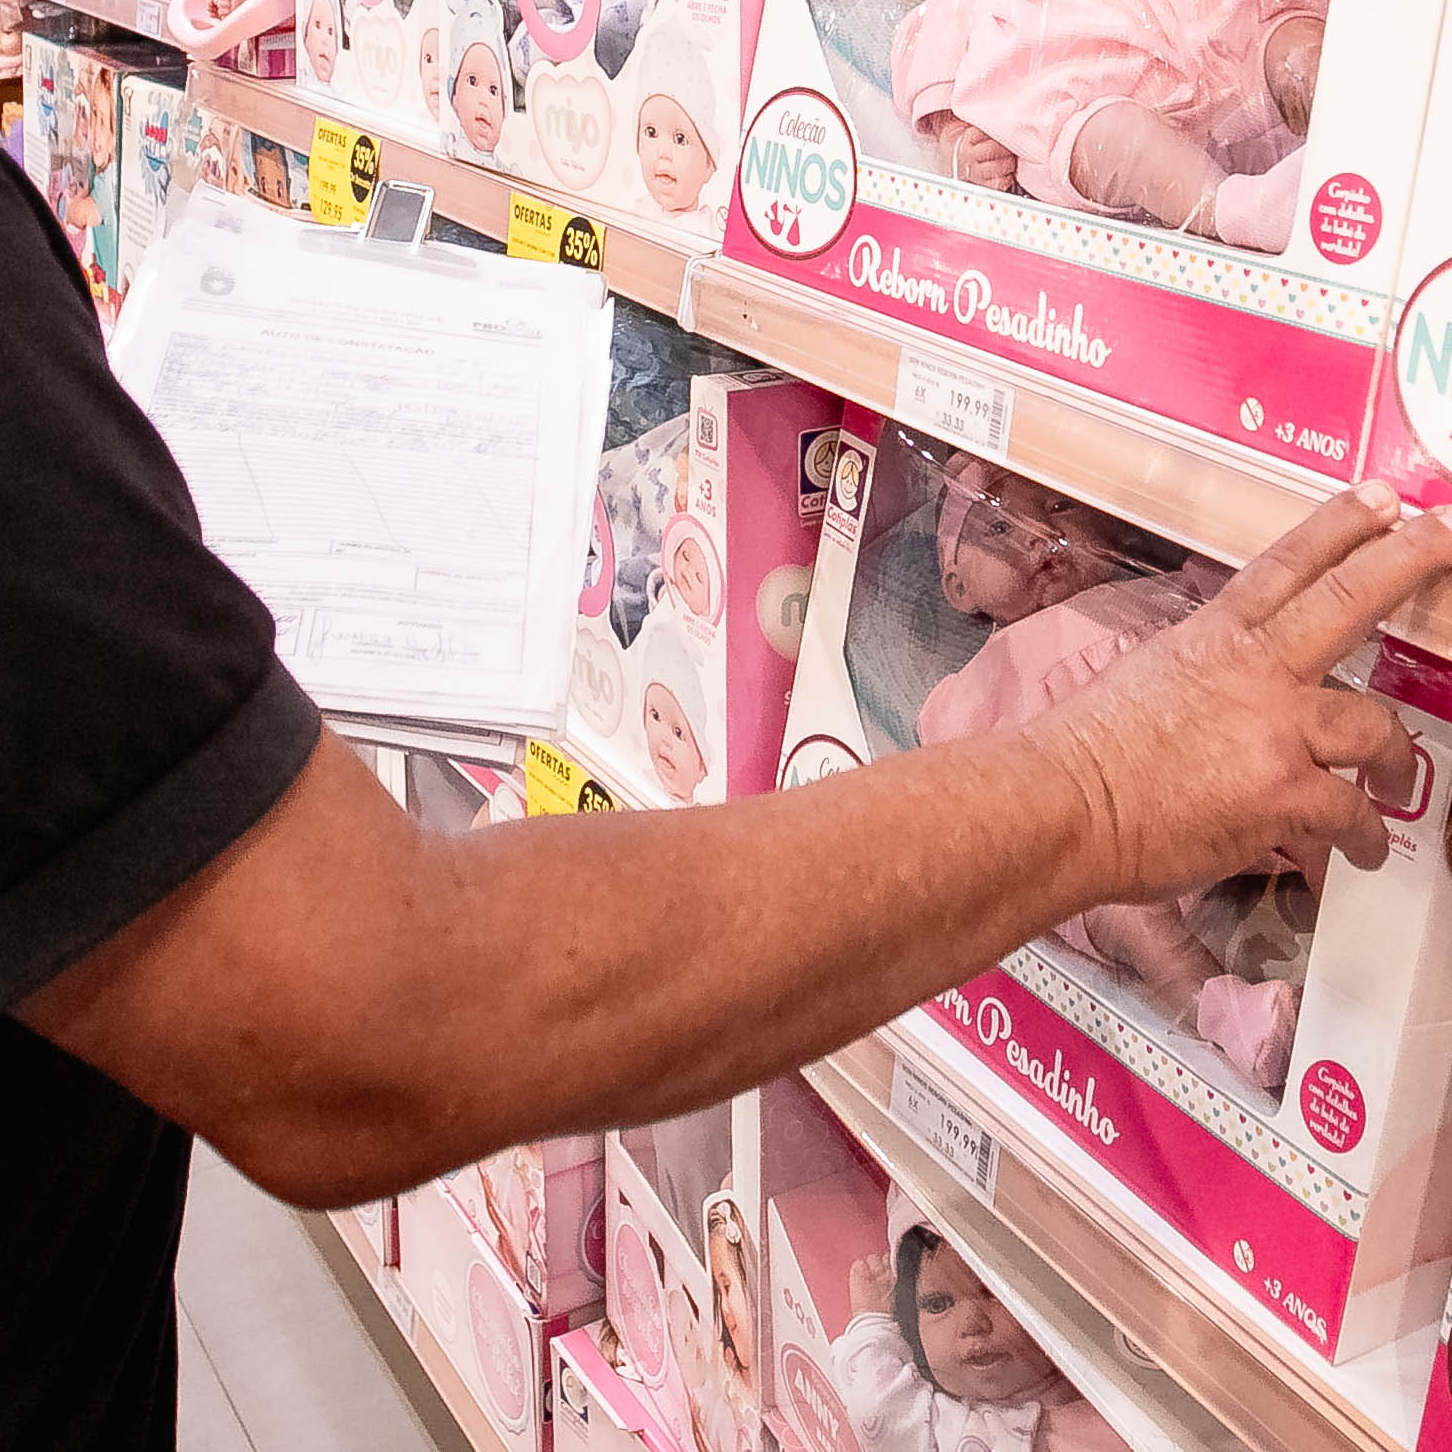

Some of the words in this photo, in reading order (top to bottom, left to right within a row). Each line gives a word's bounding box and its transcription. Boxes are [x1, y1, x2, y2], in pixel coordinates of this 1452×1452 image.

[317, 127, 347, 150] OFERTAS
[778, 110, 827, 147] Coleção
[352, 143, 377, 176] 35%
[745, 136, 848, 212] NINOS
[513, 203, 553, 232] OFERTAS
[564, 226, 598, 268] 35%
[848, 234, 950, 315] Reborn
[953, 269, 1112, 369] Pesadinho
[1273, 422, 1296, 444] +3
[1295, 428, 1347, 462] ANOS
[699, 479, 713, 501] +3
[695, 501, 717, 518] ANOS
[529, 740, 572, 783] OFERTAS
[1388, 829, 1419, 854] iplás
[976, 996, 1121, 1146] Pesadinho
[1263, 1275, 1284, 1301] +3
[1281, 1292, 1330, 1345] ANOS
